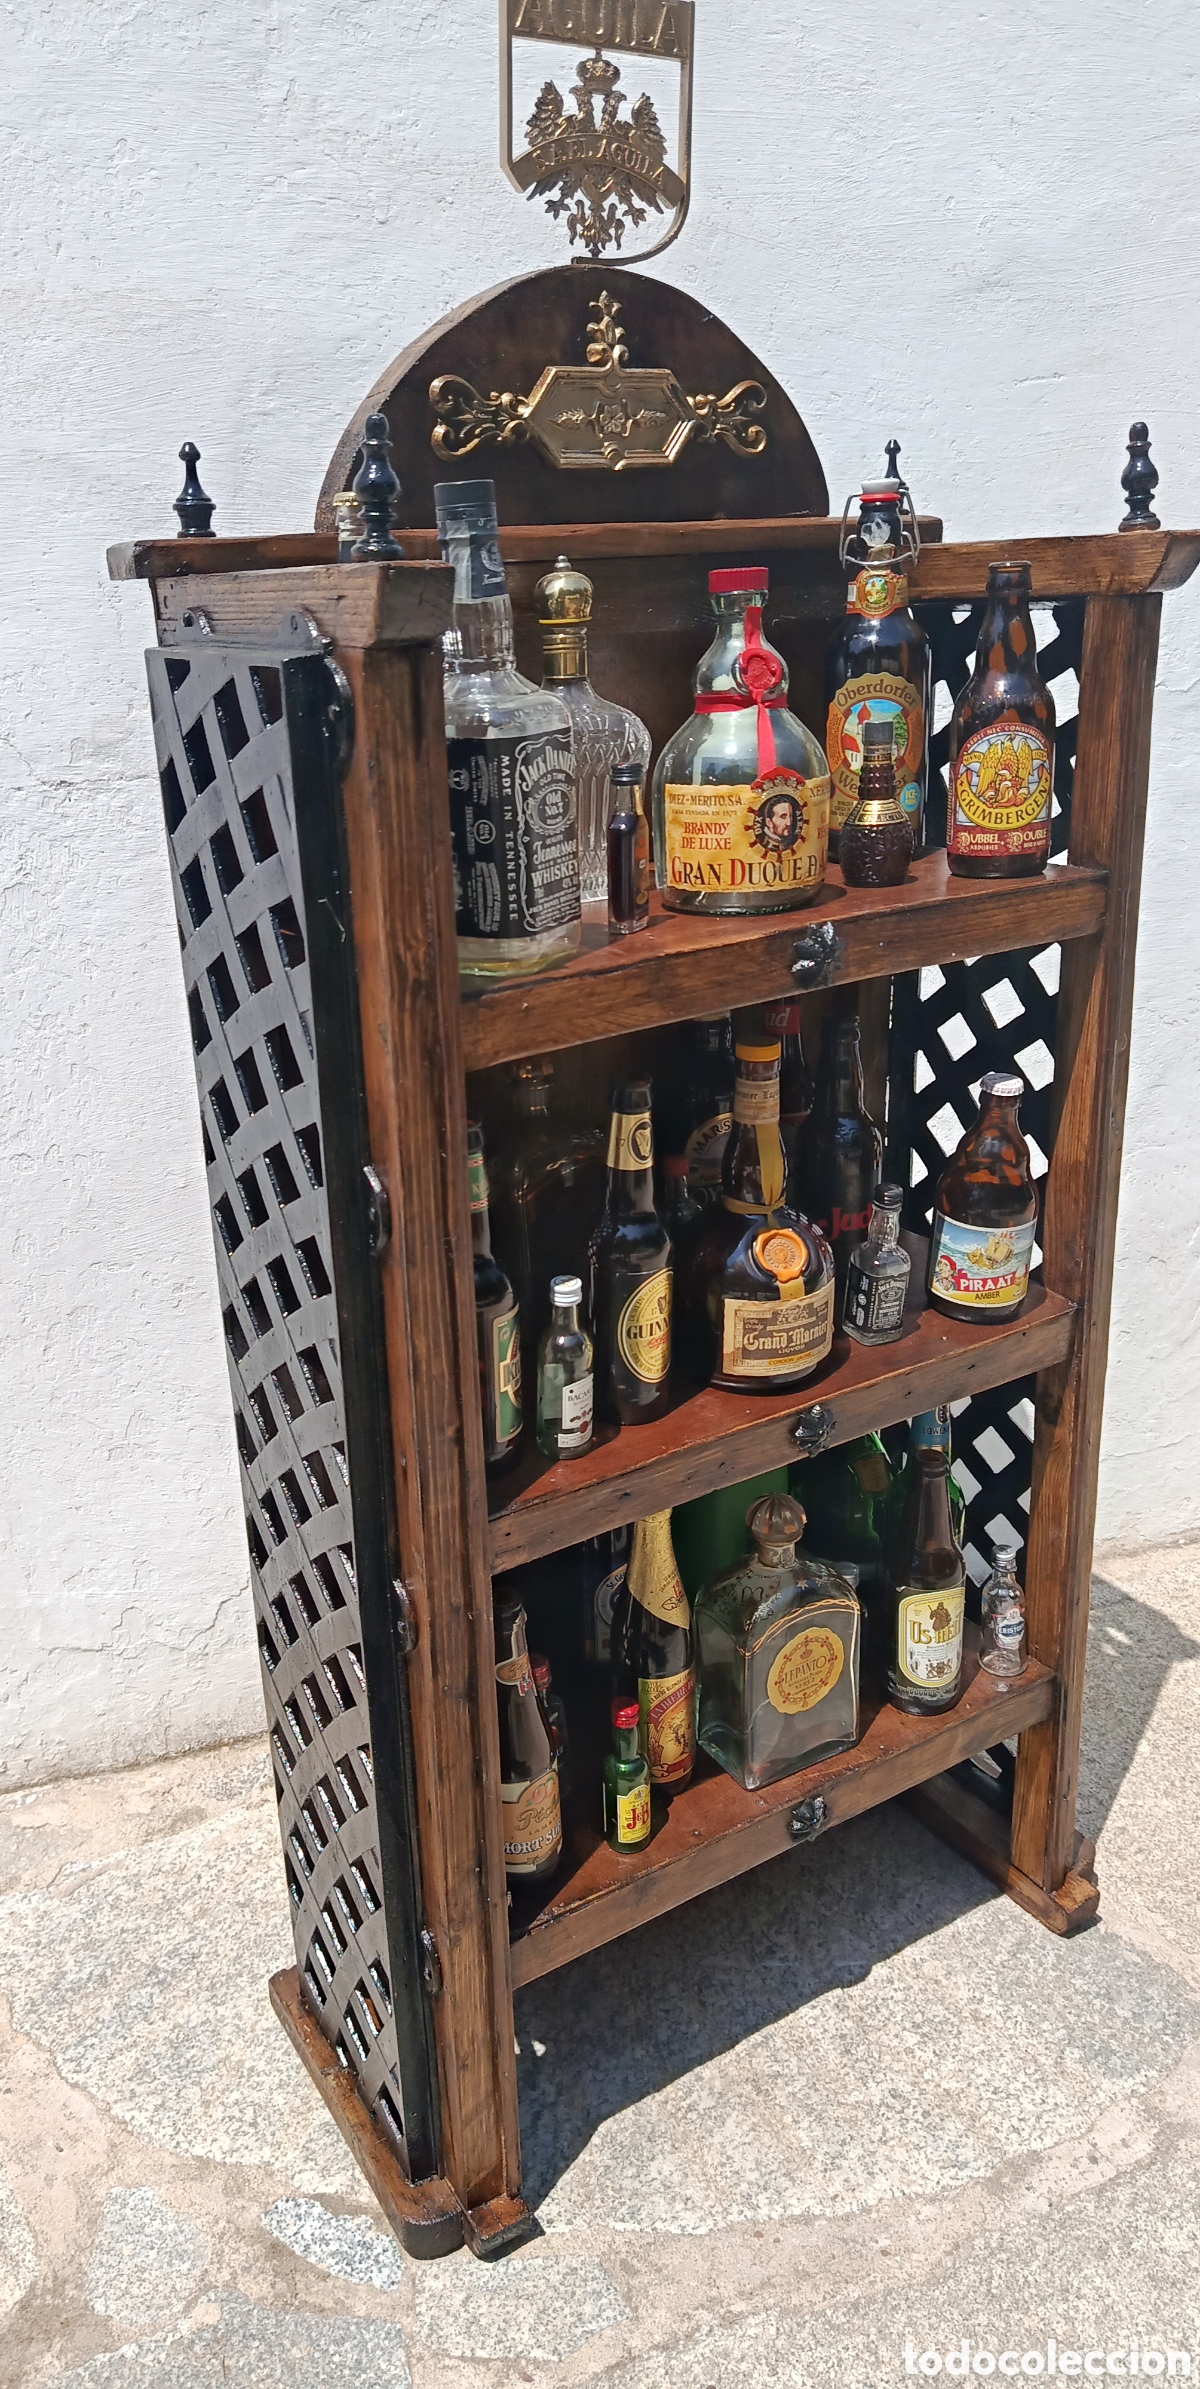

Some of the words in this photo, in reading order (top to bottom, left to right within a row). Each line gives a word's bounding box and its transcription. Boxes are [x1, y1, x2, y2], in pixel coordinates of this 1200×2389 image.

[836, 679, 917, 708] Oberdorfer
[501, 755, 512, 796] MADE
[520, 754, 548, 791] JACK
[545, 790, 562, 805] Old
[959, 788, 1048, 825] GRIMBERGEN
[503, 805, 513, 821] IN
[683, 820, 731, 836] BRANDY
[681, 836, 696, 850] DE
[698, 837, 731, 851] LUXE
[504, 831, 519, 921] TENNESSEE
[531, 859, 580, 888] WHISKEY
[671, 856, 723, 887] GRAN
[728, 858, 803, 887] DUQUE
[960, 1274, 1014, 1292] PIRAAT
[974, 1291, 1001, 1301] AMBER
[626, 1316, 671, 1341] GUINN
[744, 1331, 788, 1351] Grand
[788, 1320, 828, 1347] Marnier
[785, 1655, 827, 1684] LEPANTO
[650, 1707, 662, 1719] LA
[663, 1684, 687, 1708] BIERE
